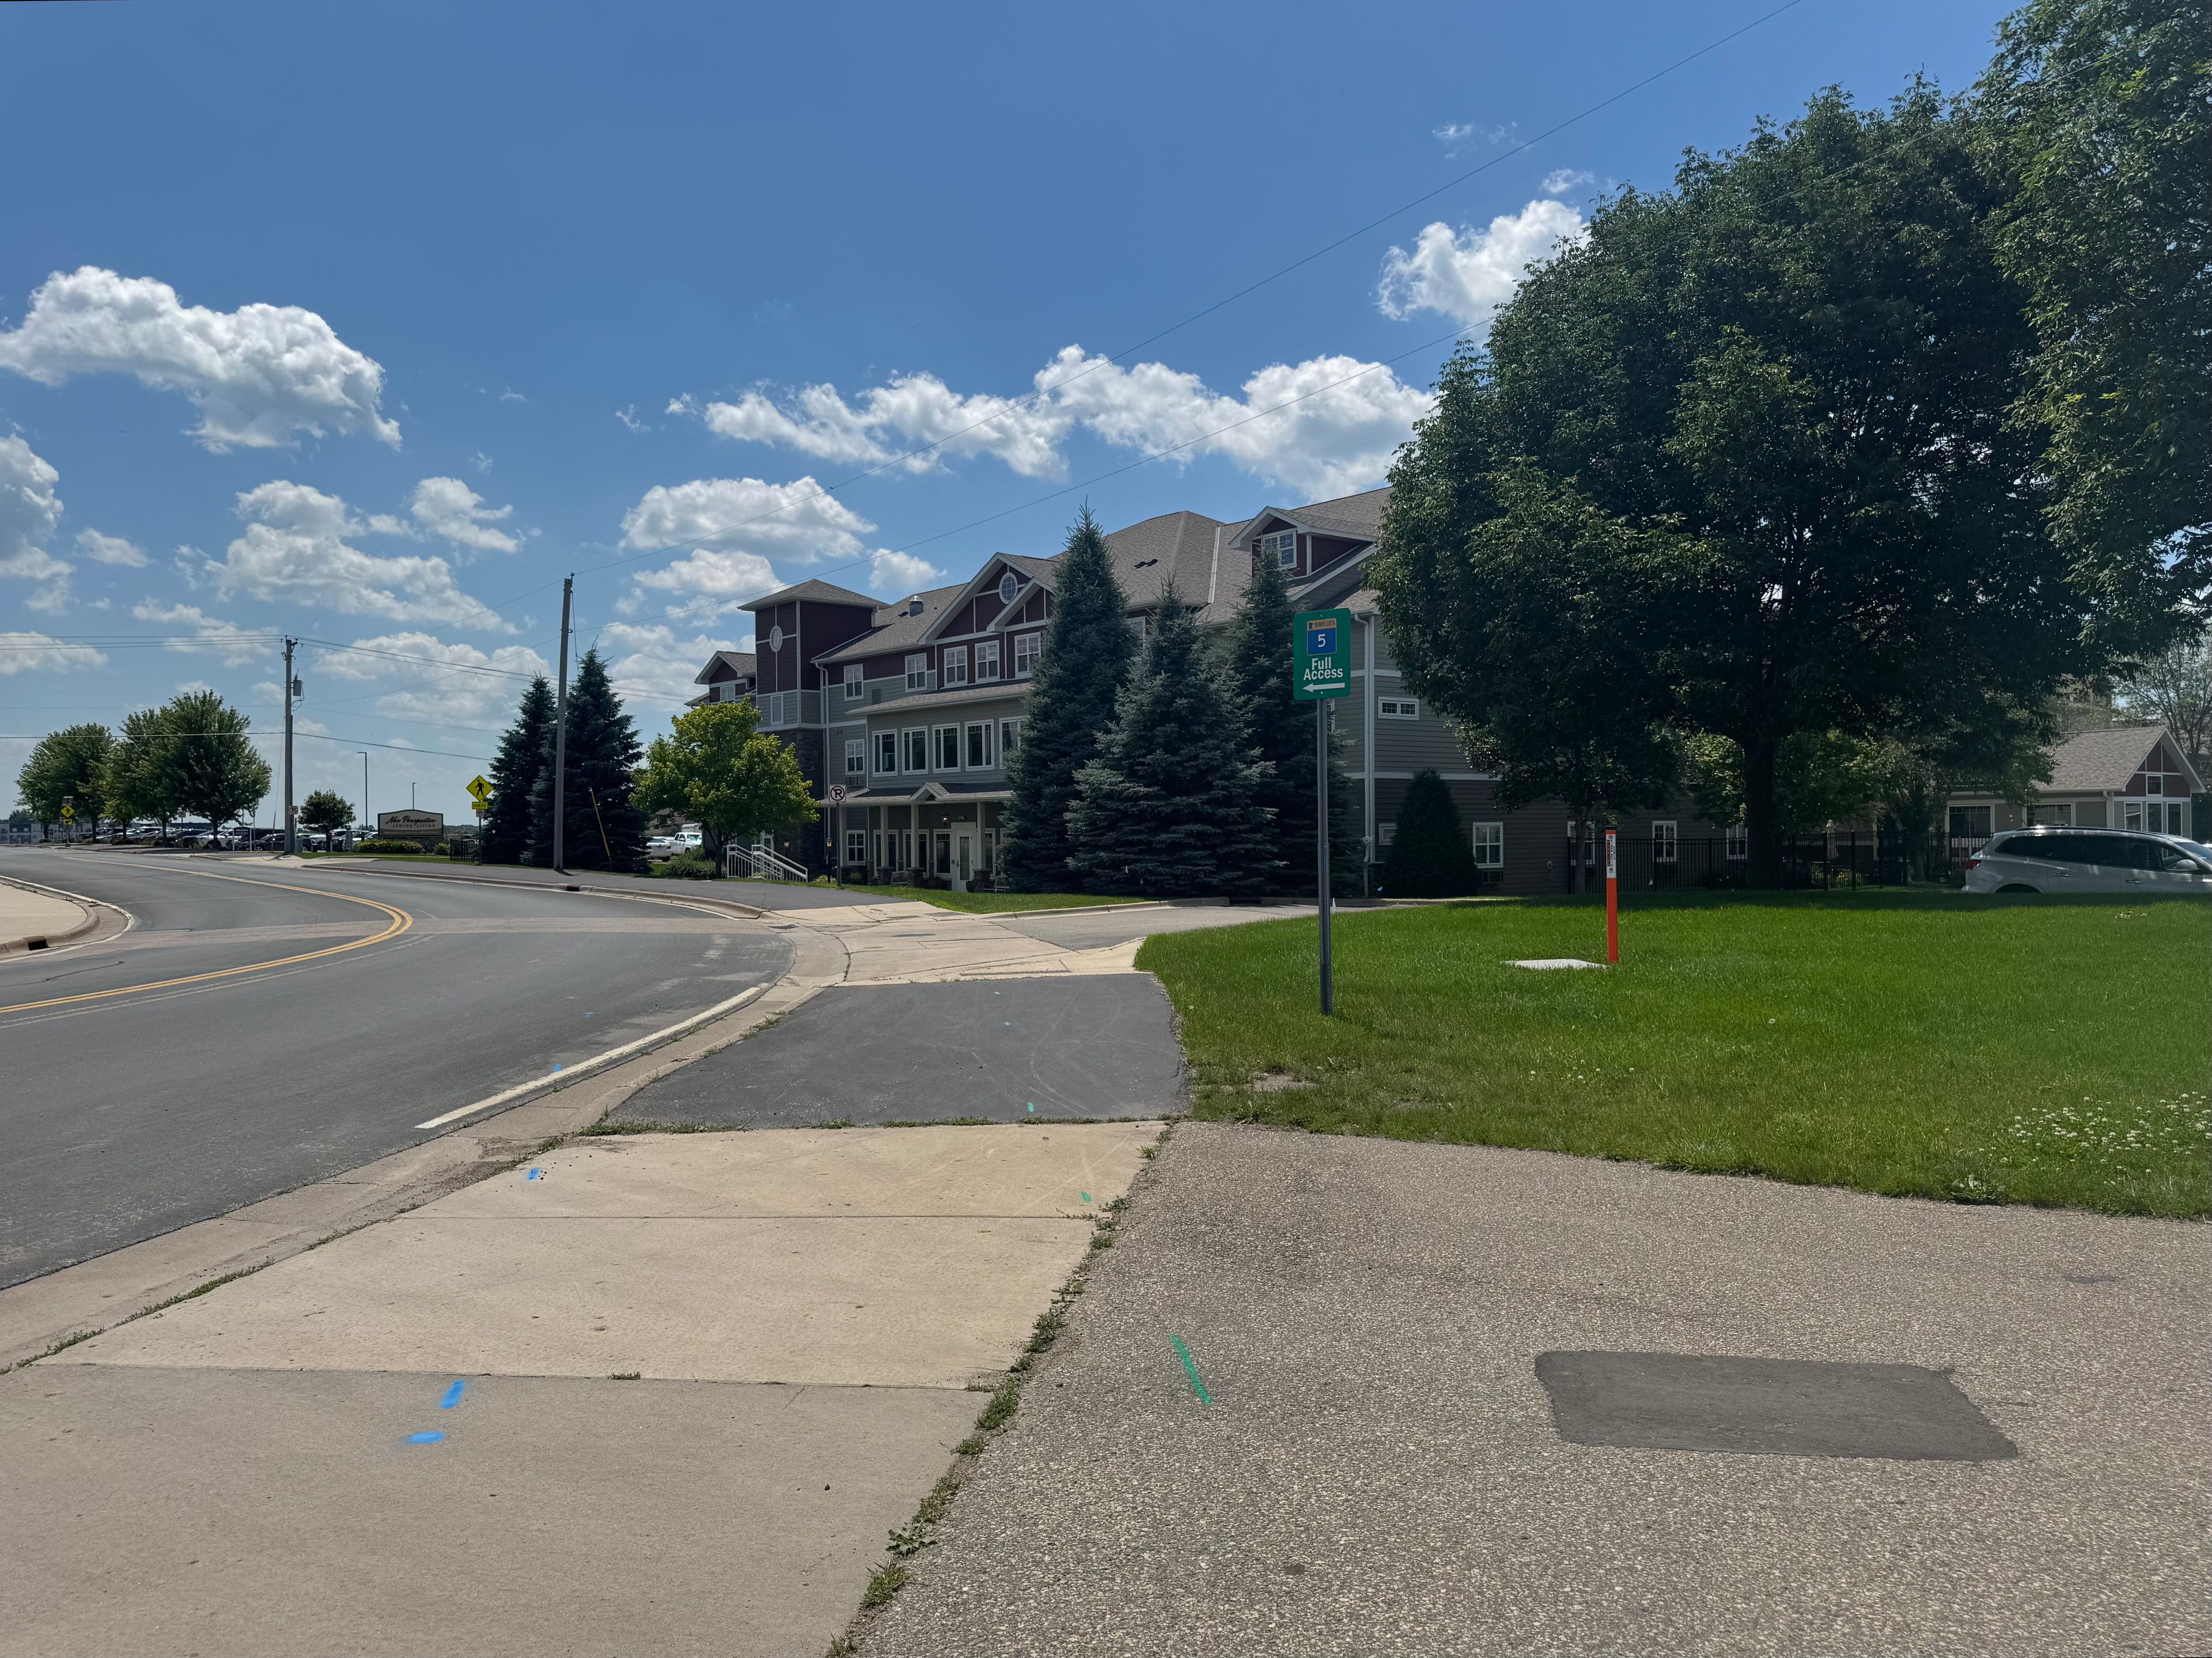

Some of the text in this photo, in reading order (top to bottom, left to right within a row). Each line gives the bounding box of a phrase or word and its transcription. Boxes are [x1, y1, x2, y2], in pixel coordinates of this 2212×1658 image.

[1317, 633, 1326, 648] 5
[1312, 657, 1332, 670] Full
[1303, 668, 1343, 681] Access
[385, 815, 401, 824] New
